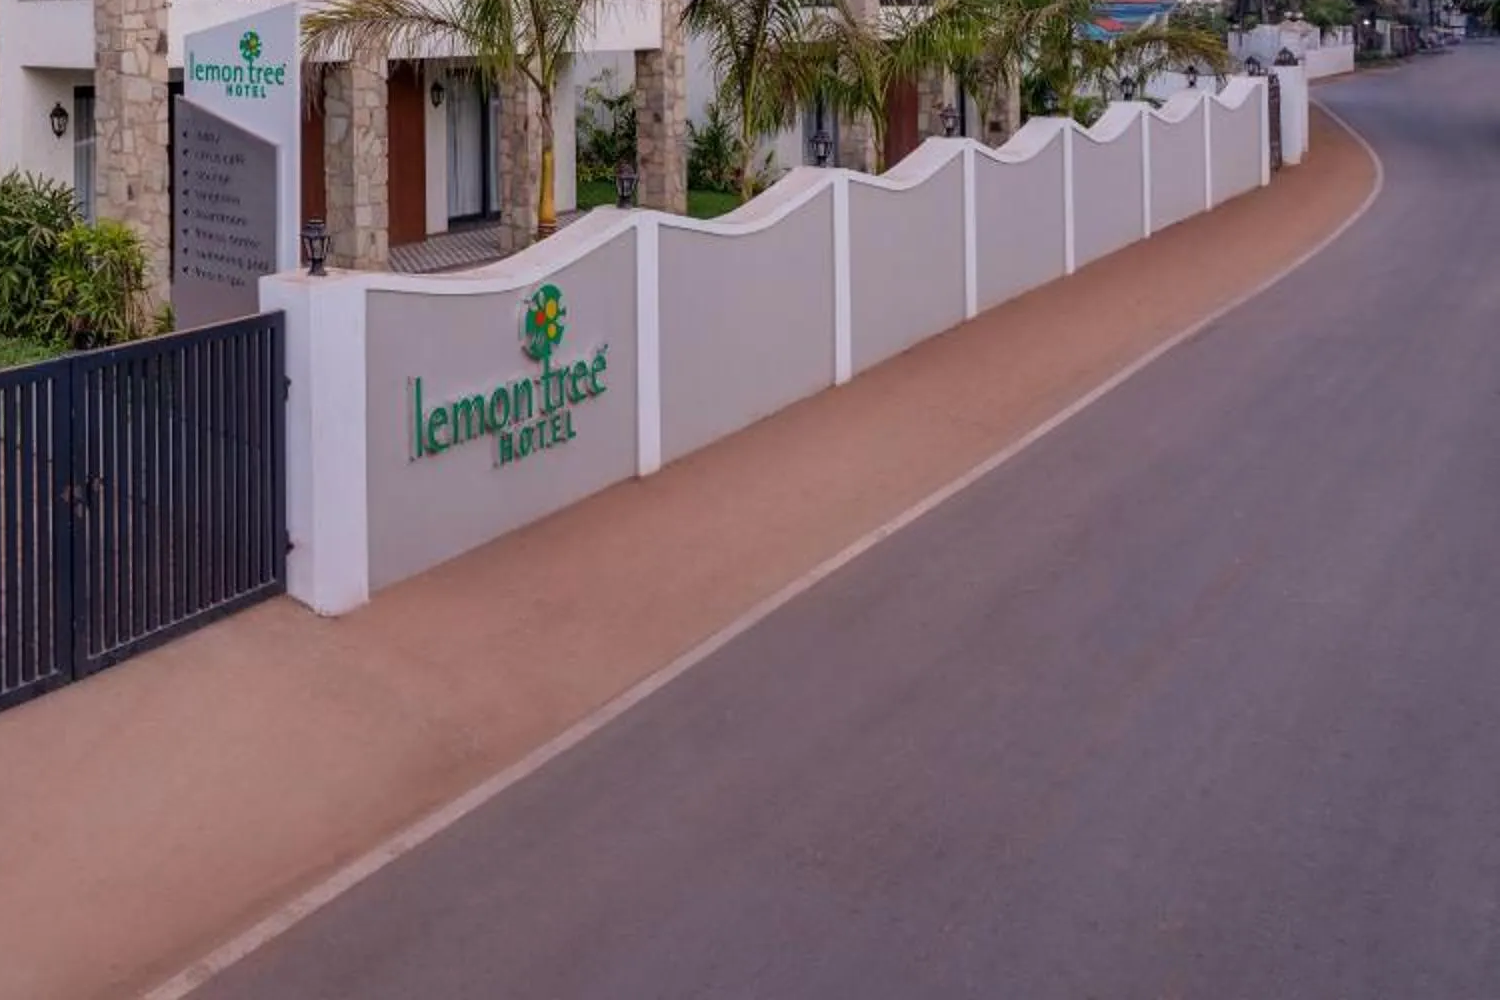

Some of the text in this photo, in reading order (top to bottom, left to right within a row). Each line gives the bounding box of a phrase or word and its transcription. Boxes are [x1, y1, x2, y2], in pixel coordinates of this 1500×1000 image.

[189, 51, 285, 85] lemon tree
[226, 84, 267, 99] HOTEL
[415, 353, 607, 458] lemon tree
[500, 410, 577, 466] HOTEL
